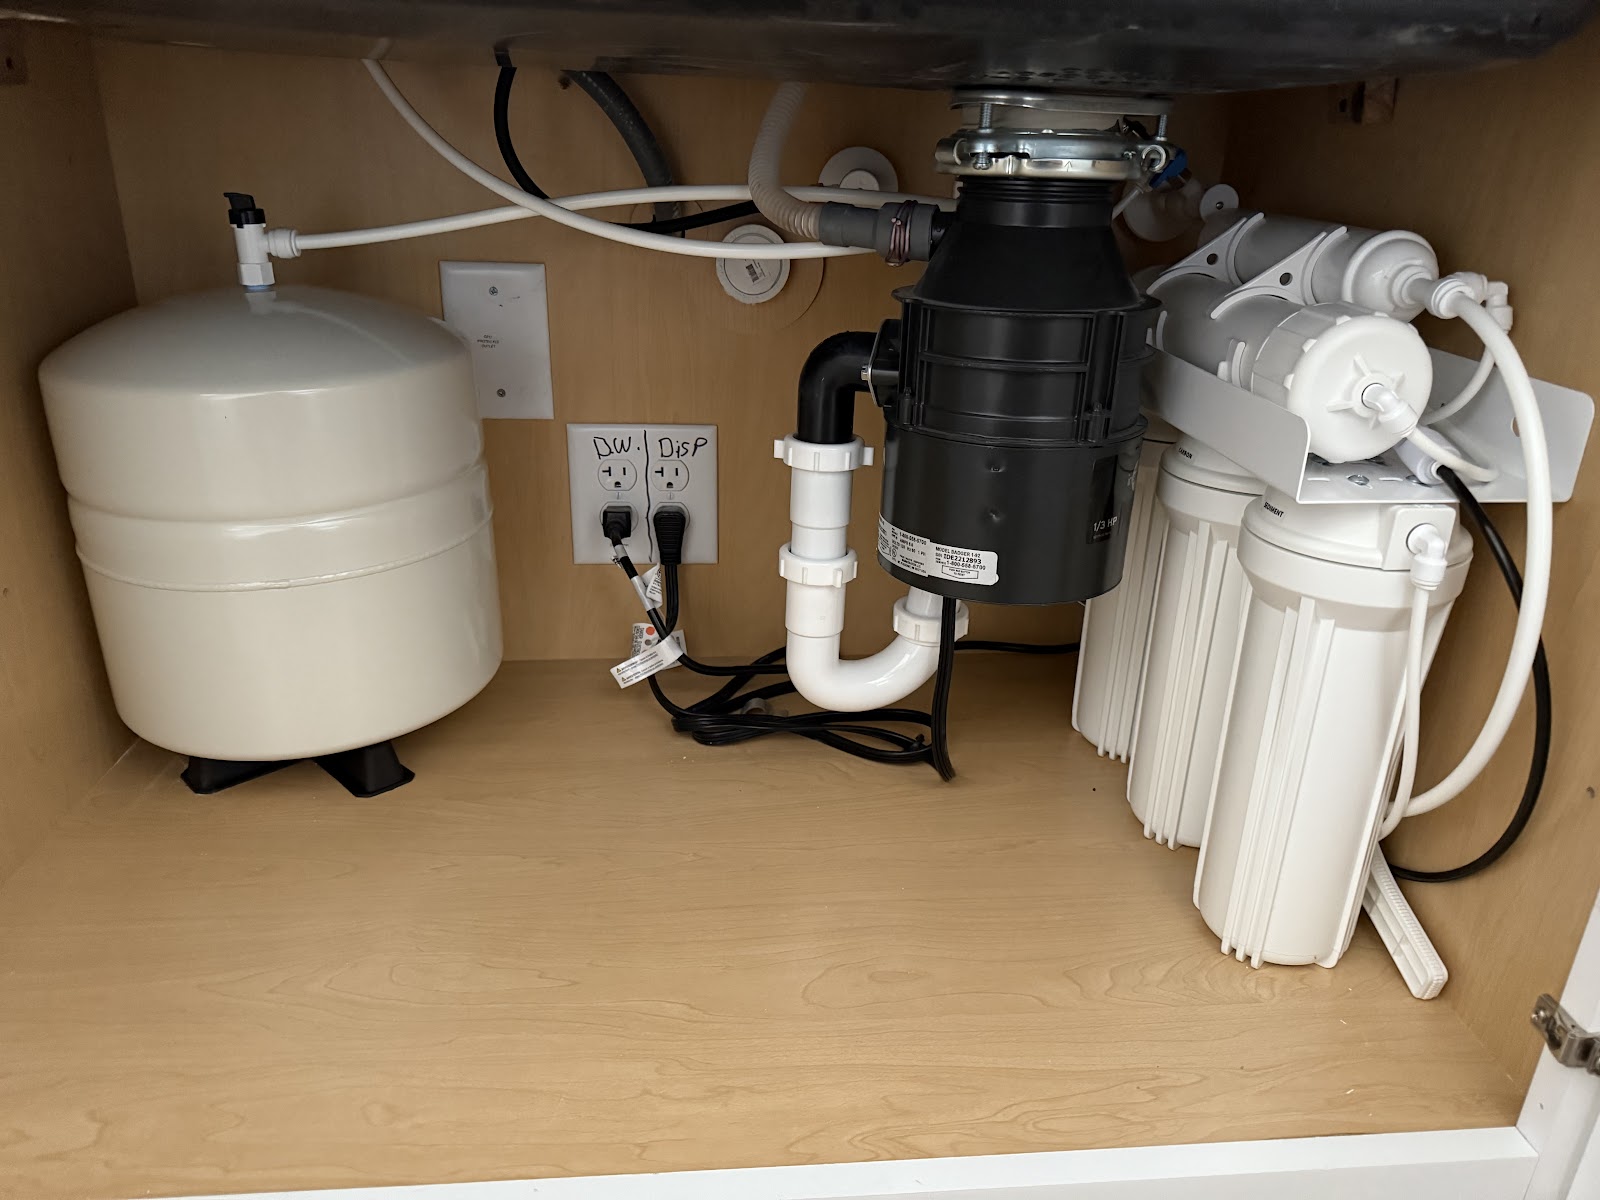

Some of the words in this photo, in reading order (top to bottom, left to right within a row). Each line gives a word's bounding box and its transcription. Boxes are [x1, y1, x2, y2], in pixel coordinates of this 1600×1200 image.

[1093, 520, 1106, 532] 1/3
[1107, 516, 1118, 528] HP
[935, 546, 950, 554] MODEL
[951, 549, 971, 557] BADGER
